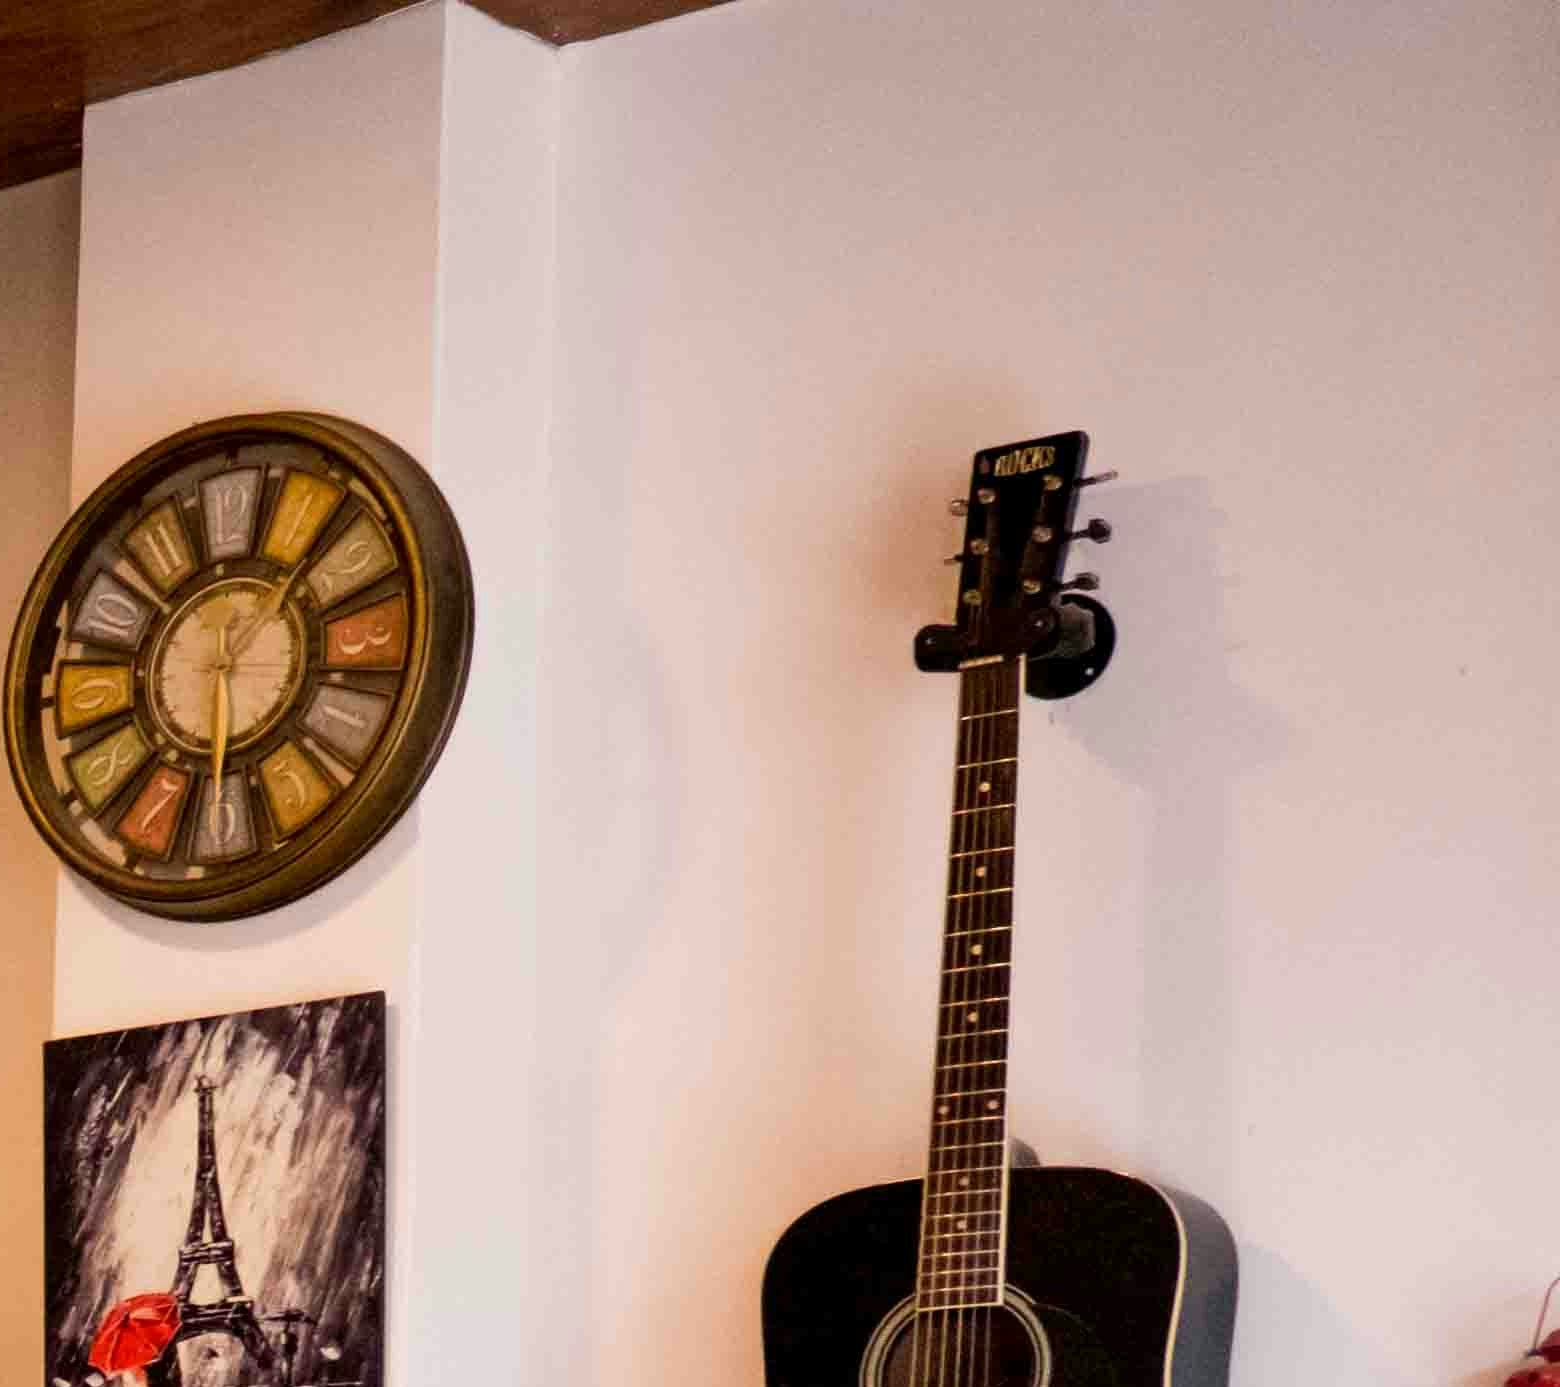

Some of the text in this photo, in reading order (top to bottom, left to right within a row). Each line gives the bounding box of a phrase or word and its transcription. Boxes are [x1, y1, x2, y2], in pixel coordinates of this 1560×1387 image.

[214, 485, 249, 546] 12
[283, 491, 314, 550] 1
[144, 521, 184, 577] 11
[87, 592, 139, 640] 10
[337, 623, 393, 656] 3
[70, 676, 119, 710] 9
[86, 742, 135, 787] 8
[272, 759, 305, 810] 5
[140, 777, 178, 834] 7
